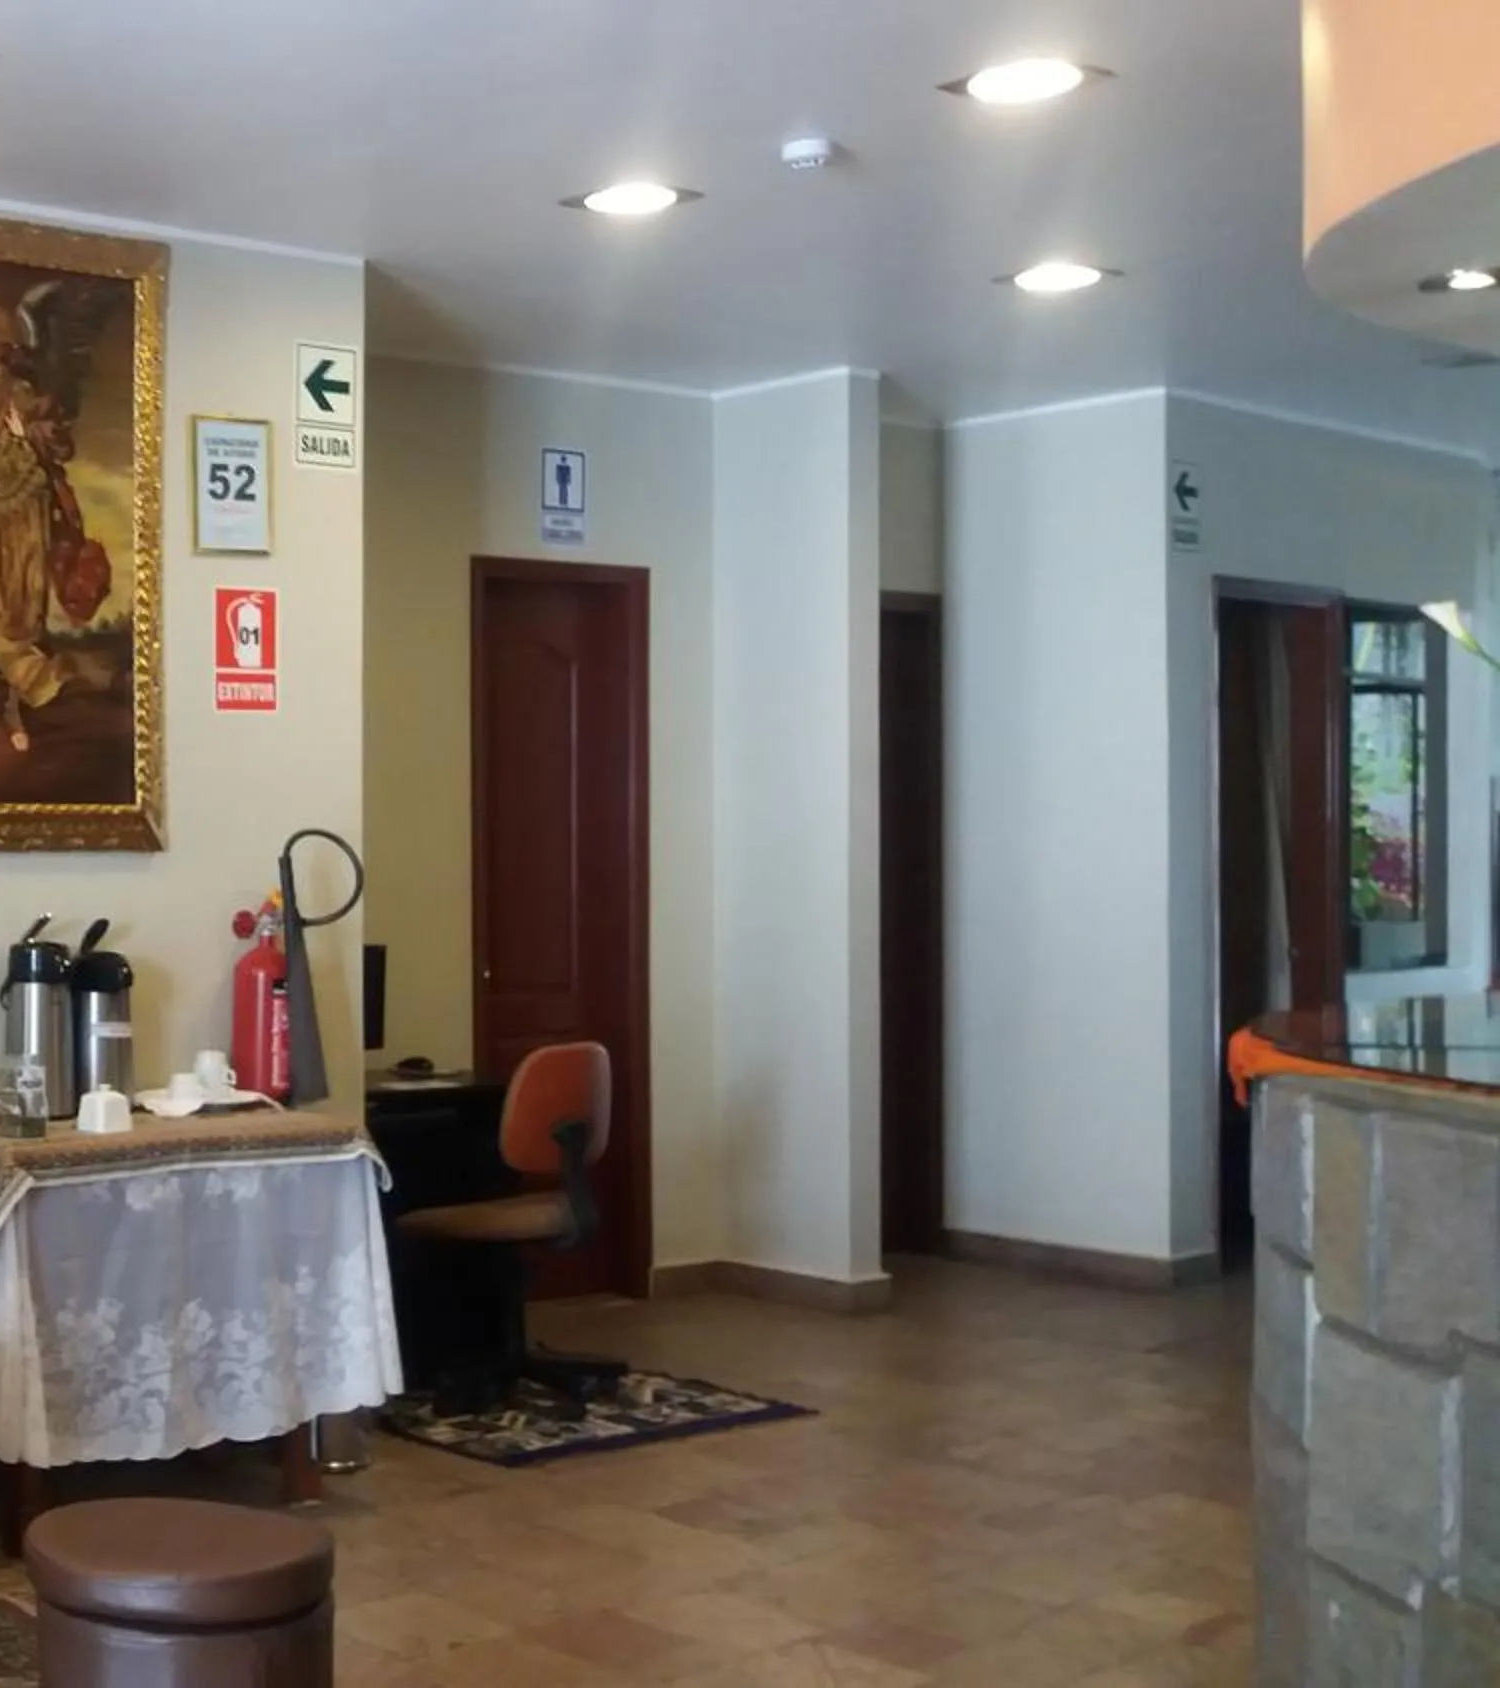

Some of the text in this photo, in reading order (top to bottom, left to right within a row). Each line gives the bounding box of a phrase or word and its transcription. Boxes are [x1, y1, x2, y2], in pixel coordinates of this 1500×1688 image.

[301, 434, 350, 457] SALIDA
[208, 463, 257, 501] 52
[240, 626, 259, 646] 01
